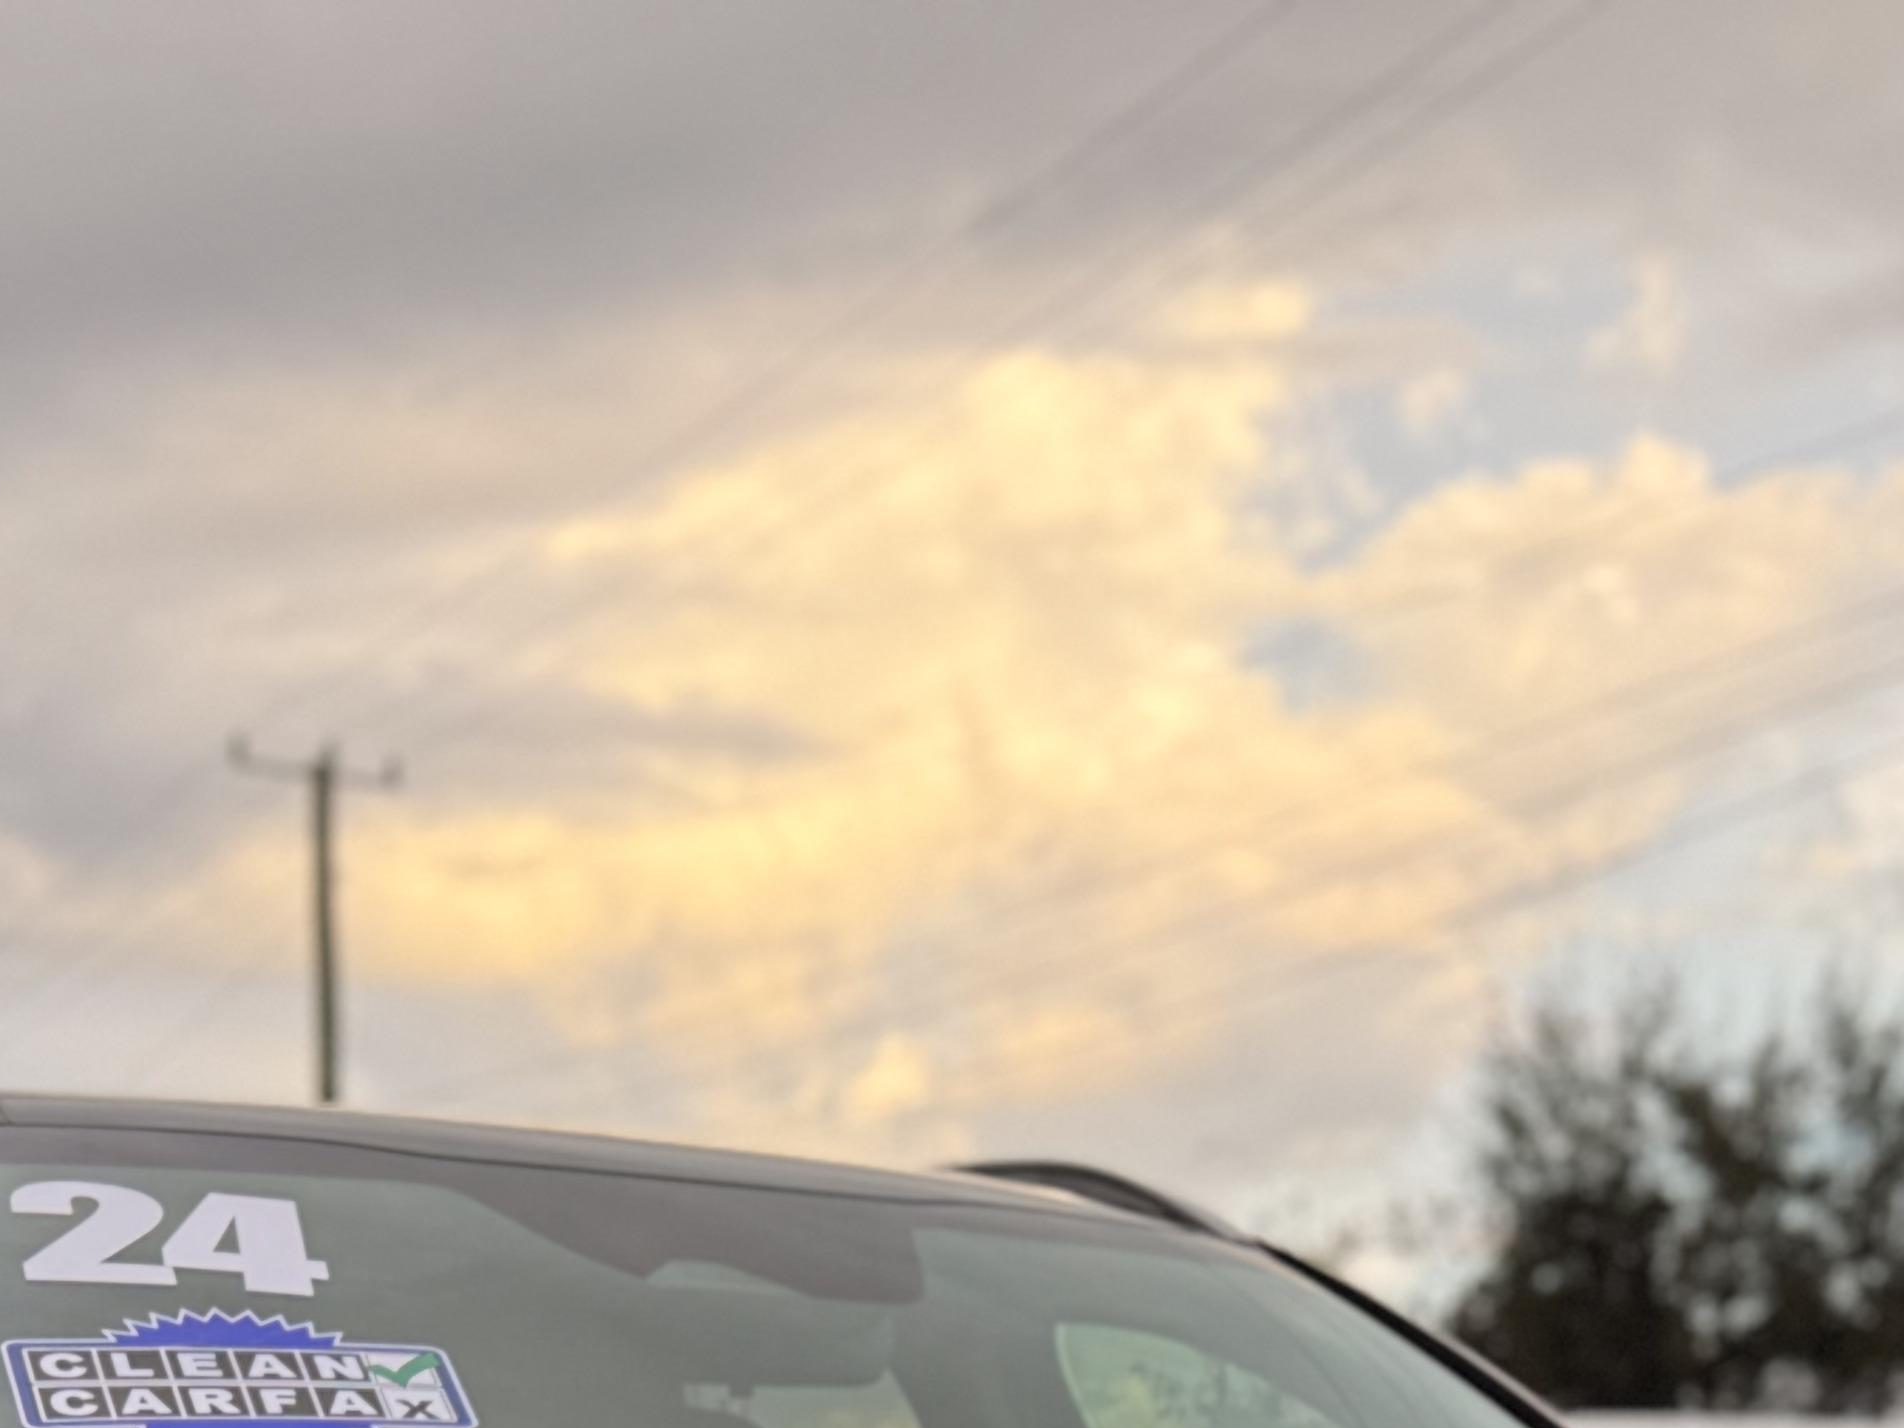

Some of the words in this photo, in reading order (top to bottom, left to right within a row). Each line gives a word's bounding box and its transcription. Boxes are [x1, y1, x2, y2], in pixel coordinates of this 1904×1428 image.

[9, 1180, 330, 1296] 24
[38, 1351, 368, 1381] CLEAN
[49, 1387, 435, 1420] CARFAX
